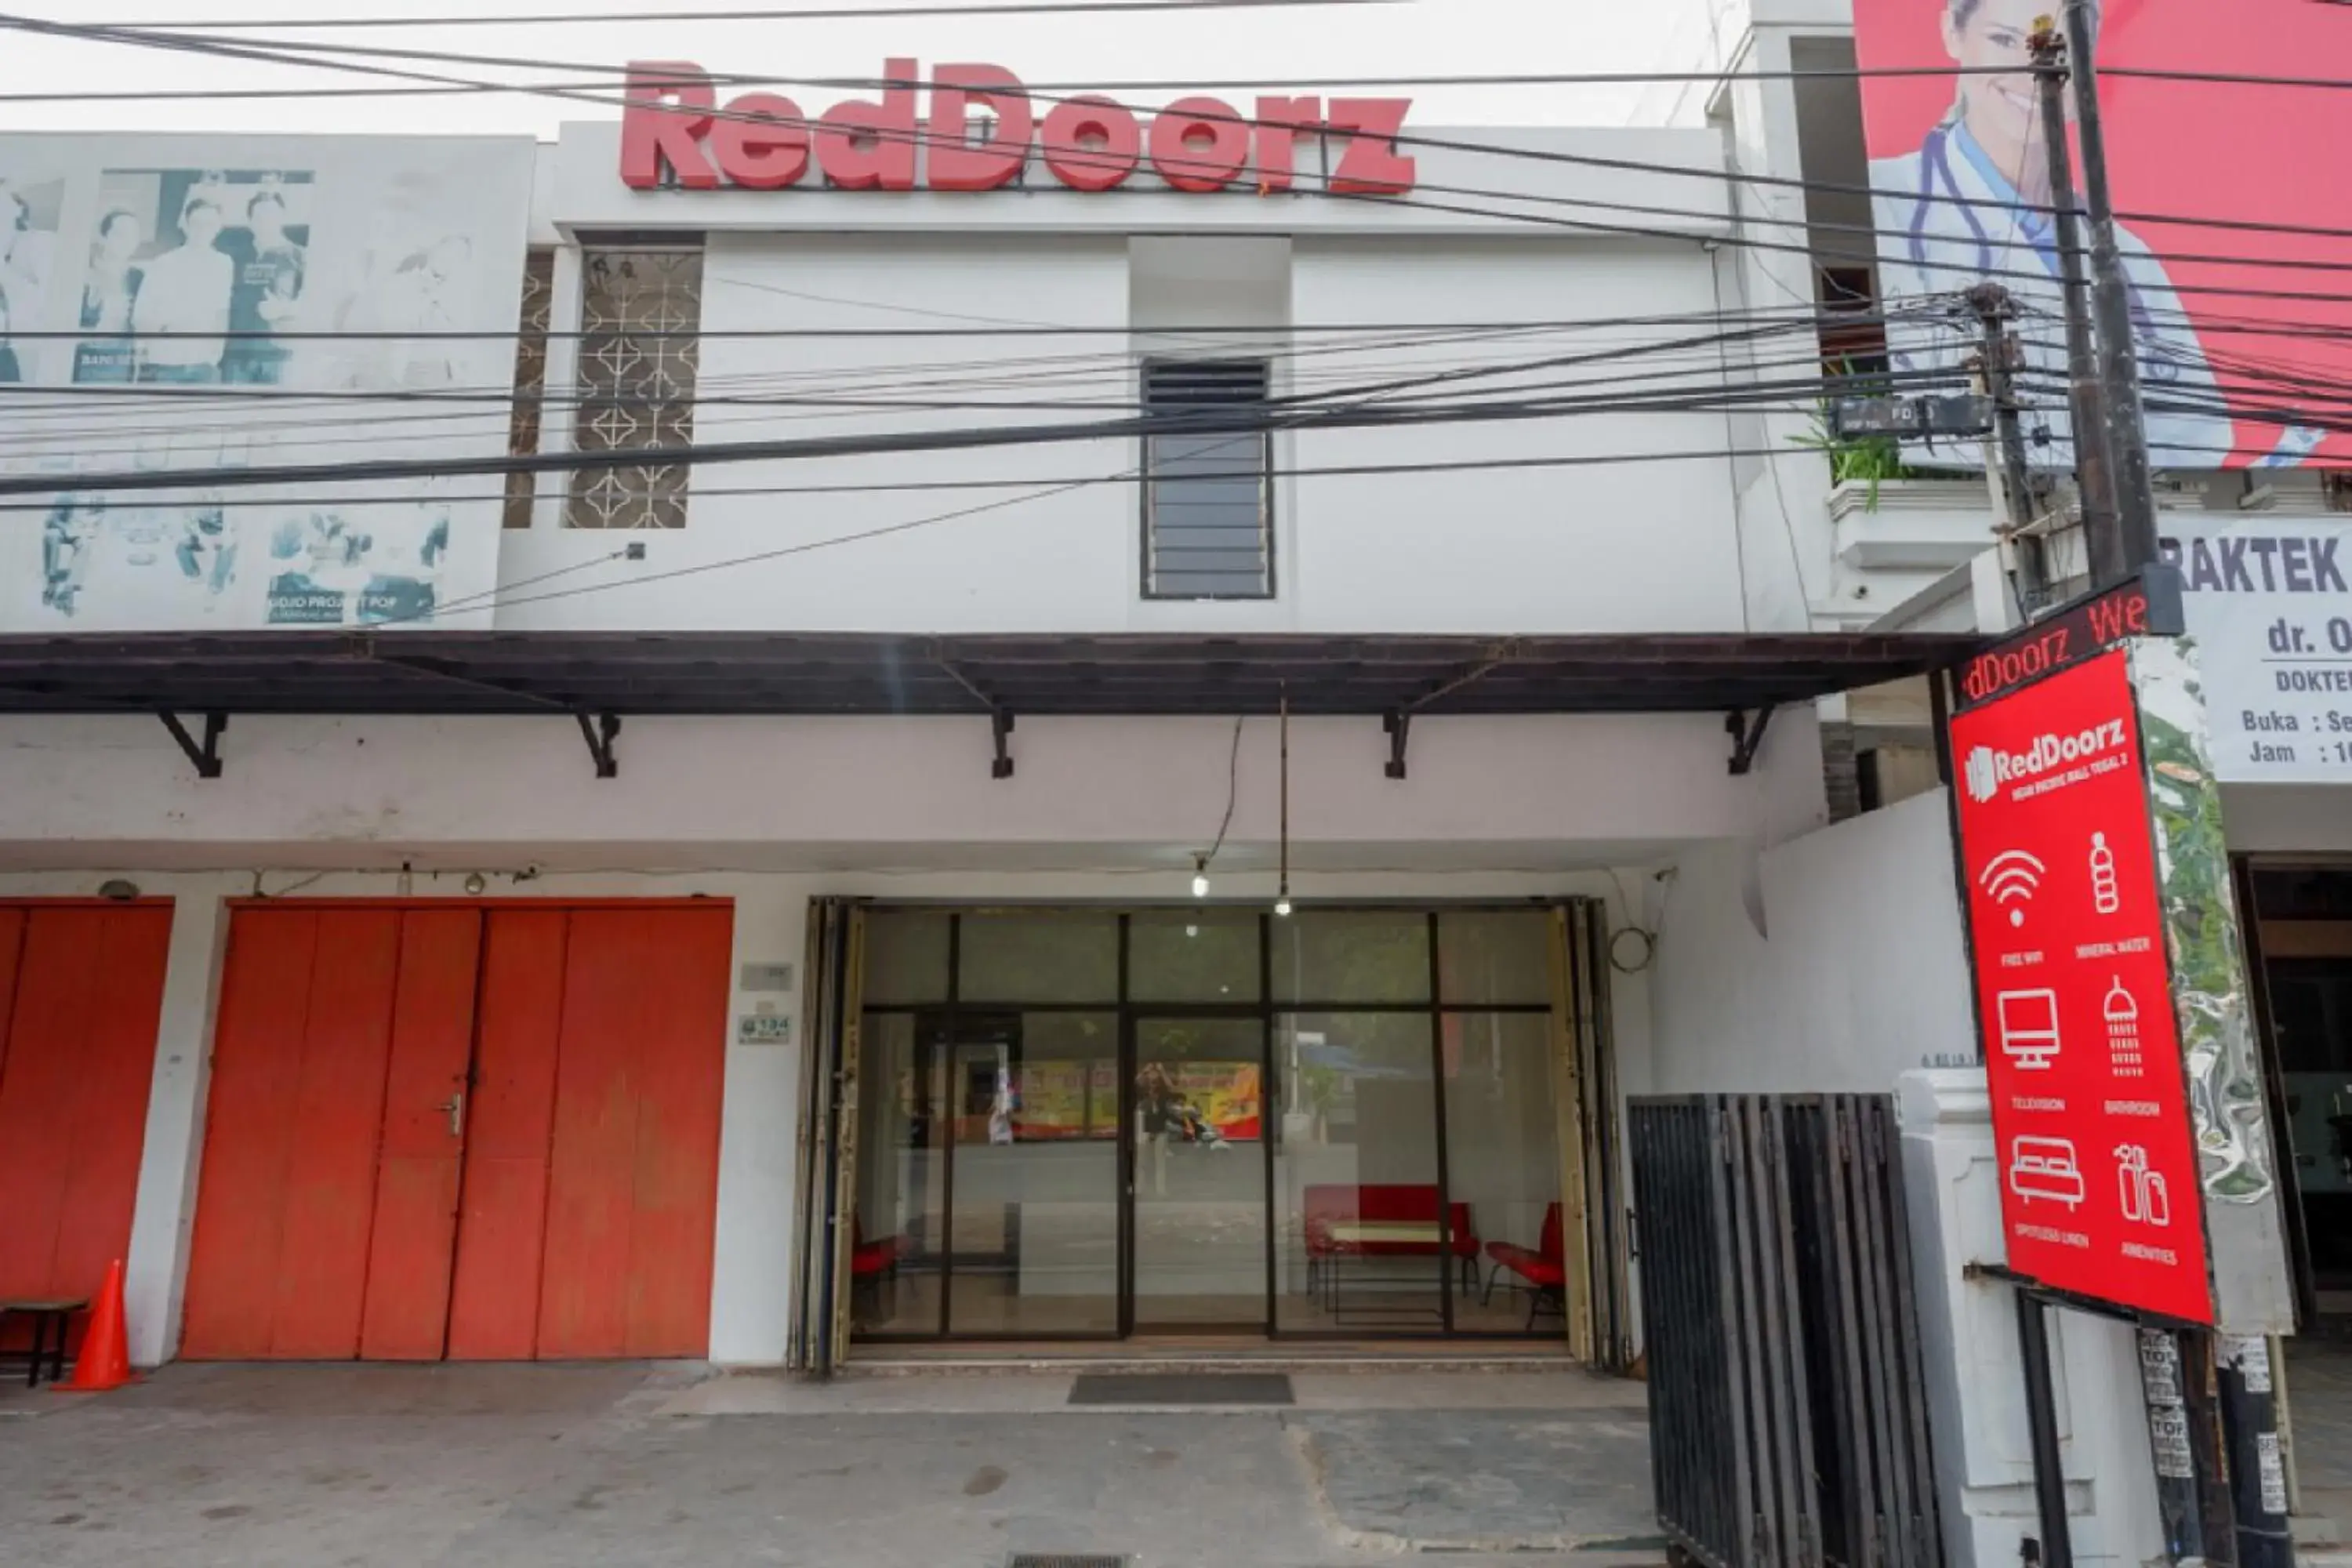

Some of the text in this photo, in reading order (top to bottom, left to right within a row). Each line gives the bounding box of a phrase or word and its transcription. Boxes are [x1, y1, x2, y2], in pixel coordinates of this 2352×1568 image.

[619, 57, 1416, 194] RedDoorz
[2158, 537, 2349, 593] RAKTEK
[1963, 595, 2147, 701] dDoorz We
[2267, 616, 2316, 654] dr.
[2275, 670, 2352, 691] DOKTE
[2241, 710, 2299, 731] Buka
[1994, 717, 2127, 783] RedDoorz
[2249, 741, 2296, 763] Jam
[2011, 1095, 2066, 1112] TELEVISION
